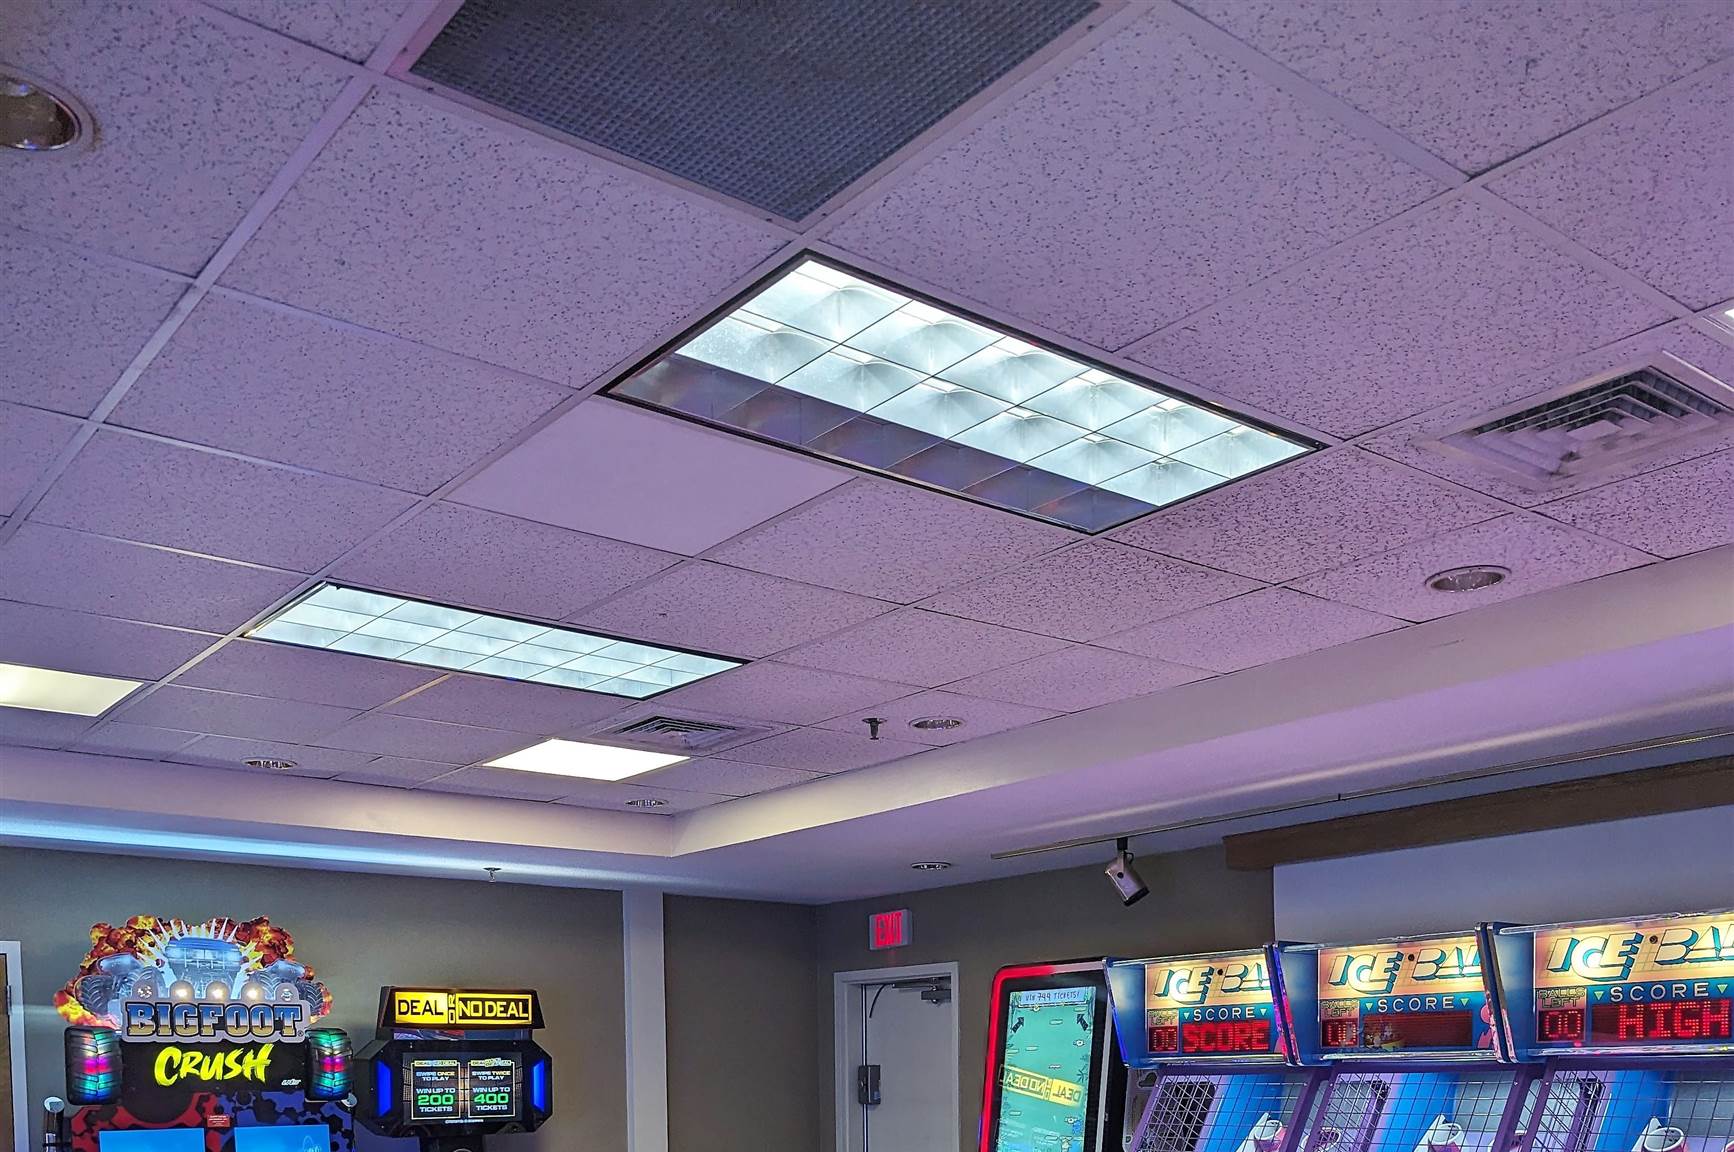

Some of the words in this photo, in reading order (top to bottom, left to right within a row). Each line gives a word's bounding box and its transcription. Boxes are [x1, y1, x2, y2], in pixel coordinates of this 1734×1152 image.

[1546, 932, 1644, 982] ICE
[1328, 951, 1404, 994] ICE
[1153, 966, 1215, 1005] ICE
[1220, 962, 1270, 993] BA
[1537, 987, 1586, 999] BALLS
[1610, 982, 1709, 1002] SCORE
[398, 1000, 444, 1016] DEAL
[458, 1000, 482, 1018] NO
[485, 1001, 529, 1018] DEAL
[1378, 996, 1454, 1013] SCORE
[1541, 997, 1581, 1009] LEFT
[125, 1002, 302, 1037] BIGFOOT
[1193, 1007, 1255, 1022] SCORE
[1544, 1010, 1582, 1038] 00
[1617, 998, 1730, 1041] HIGH
[1182, 1020, 1270, 1053] SCORE
[154, 1043, 275, 1087] CRUSH
[417, 1094, 454, 1106] 200
[474, 1093, 509, 1104] 400
